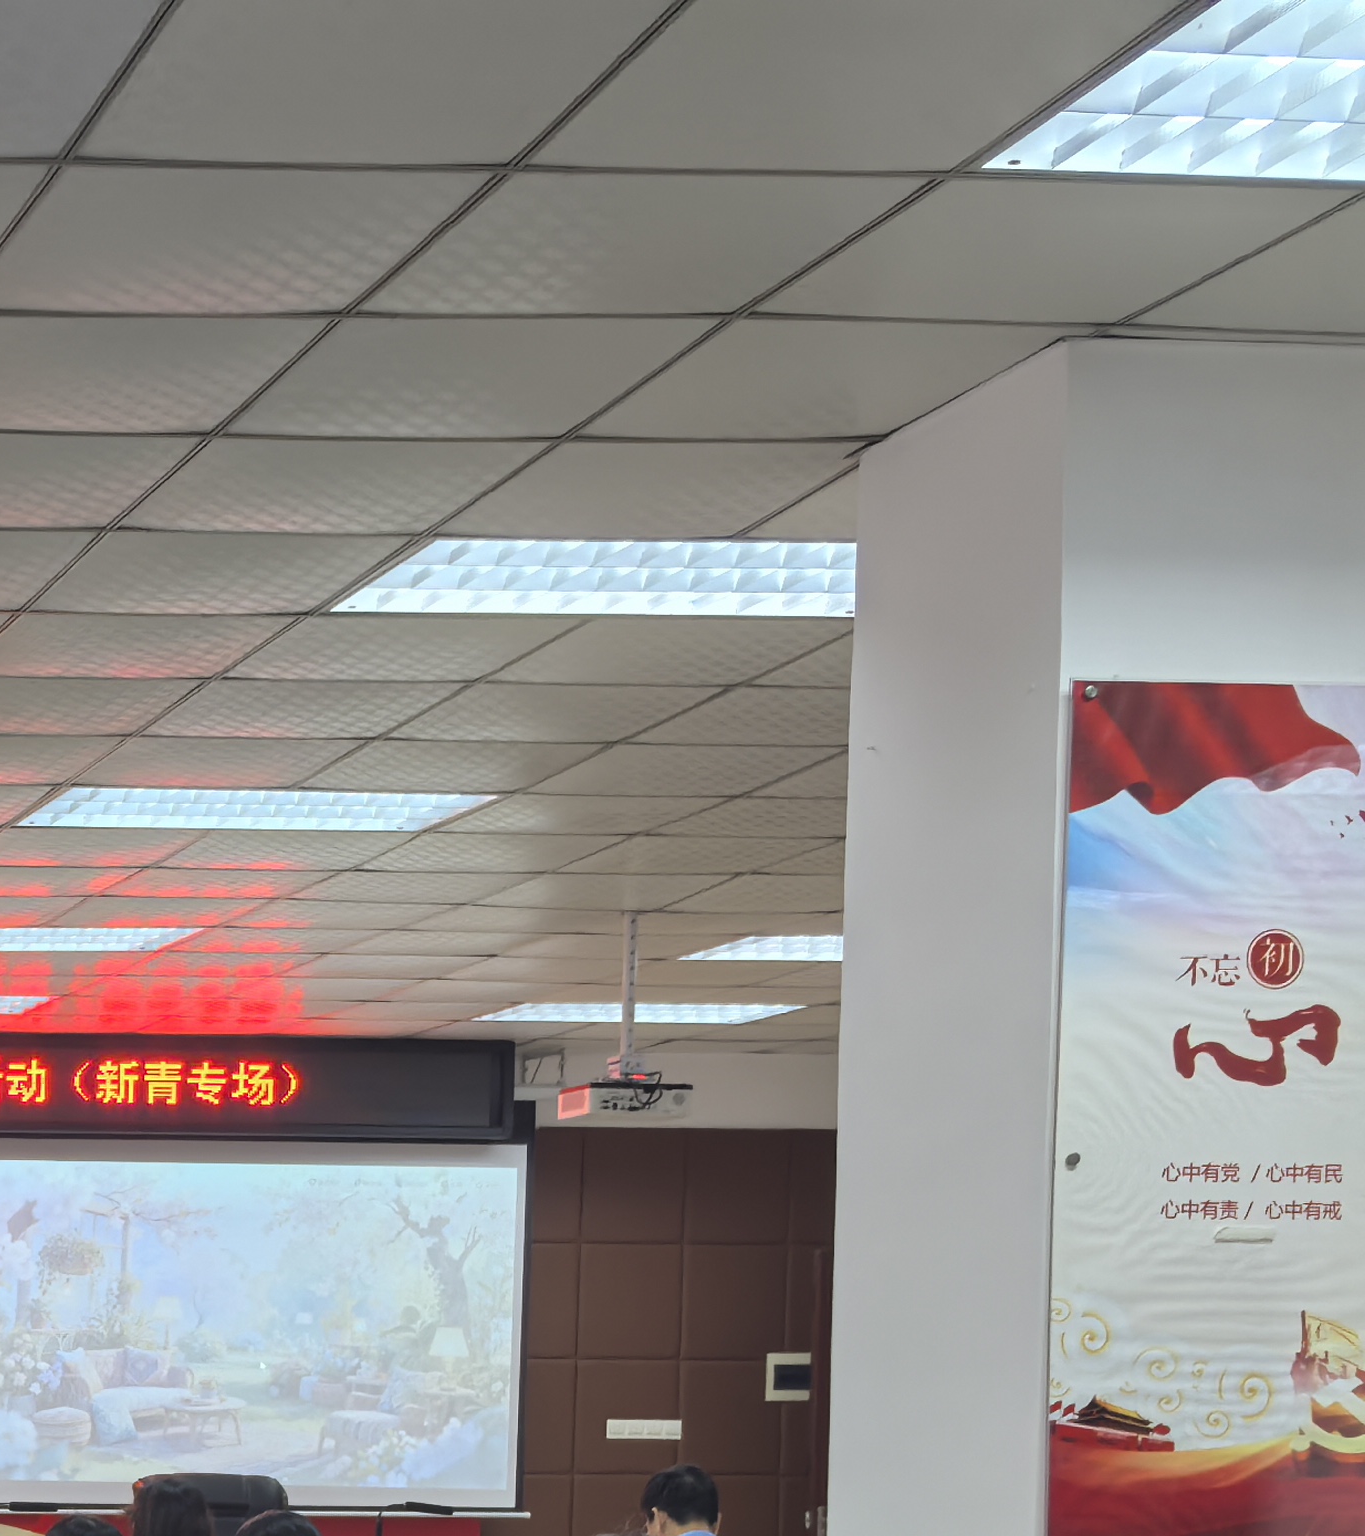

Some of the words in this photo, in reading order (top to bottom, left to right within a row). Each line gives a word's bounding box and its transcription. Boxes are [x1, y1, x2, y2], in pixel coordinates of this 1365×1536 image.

[1161, 1162, 1240, 1184] 心中有党
[1265, 1162, 1344, 1184] 心中有民
[1160, 1199, 1239, 1221] 心中有责
[1264, 1200, 1342, 1221] 心中有戒
